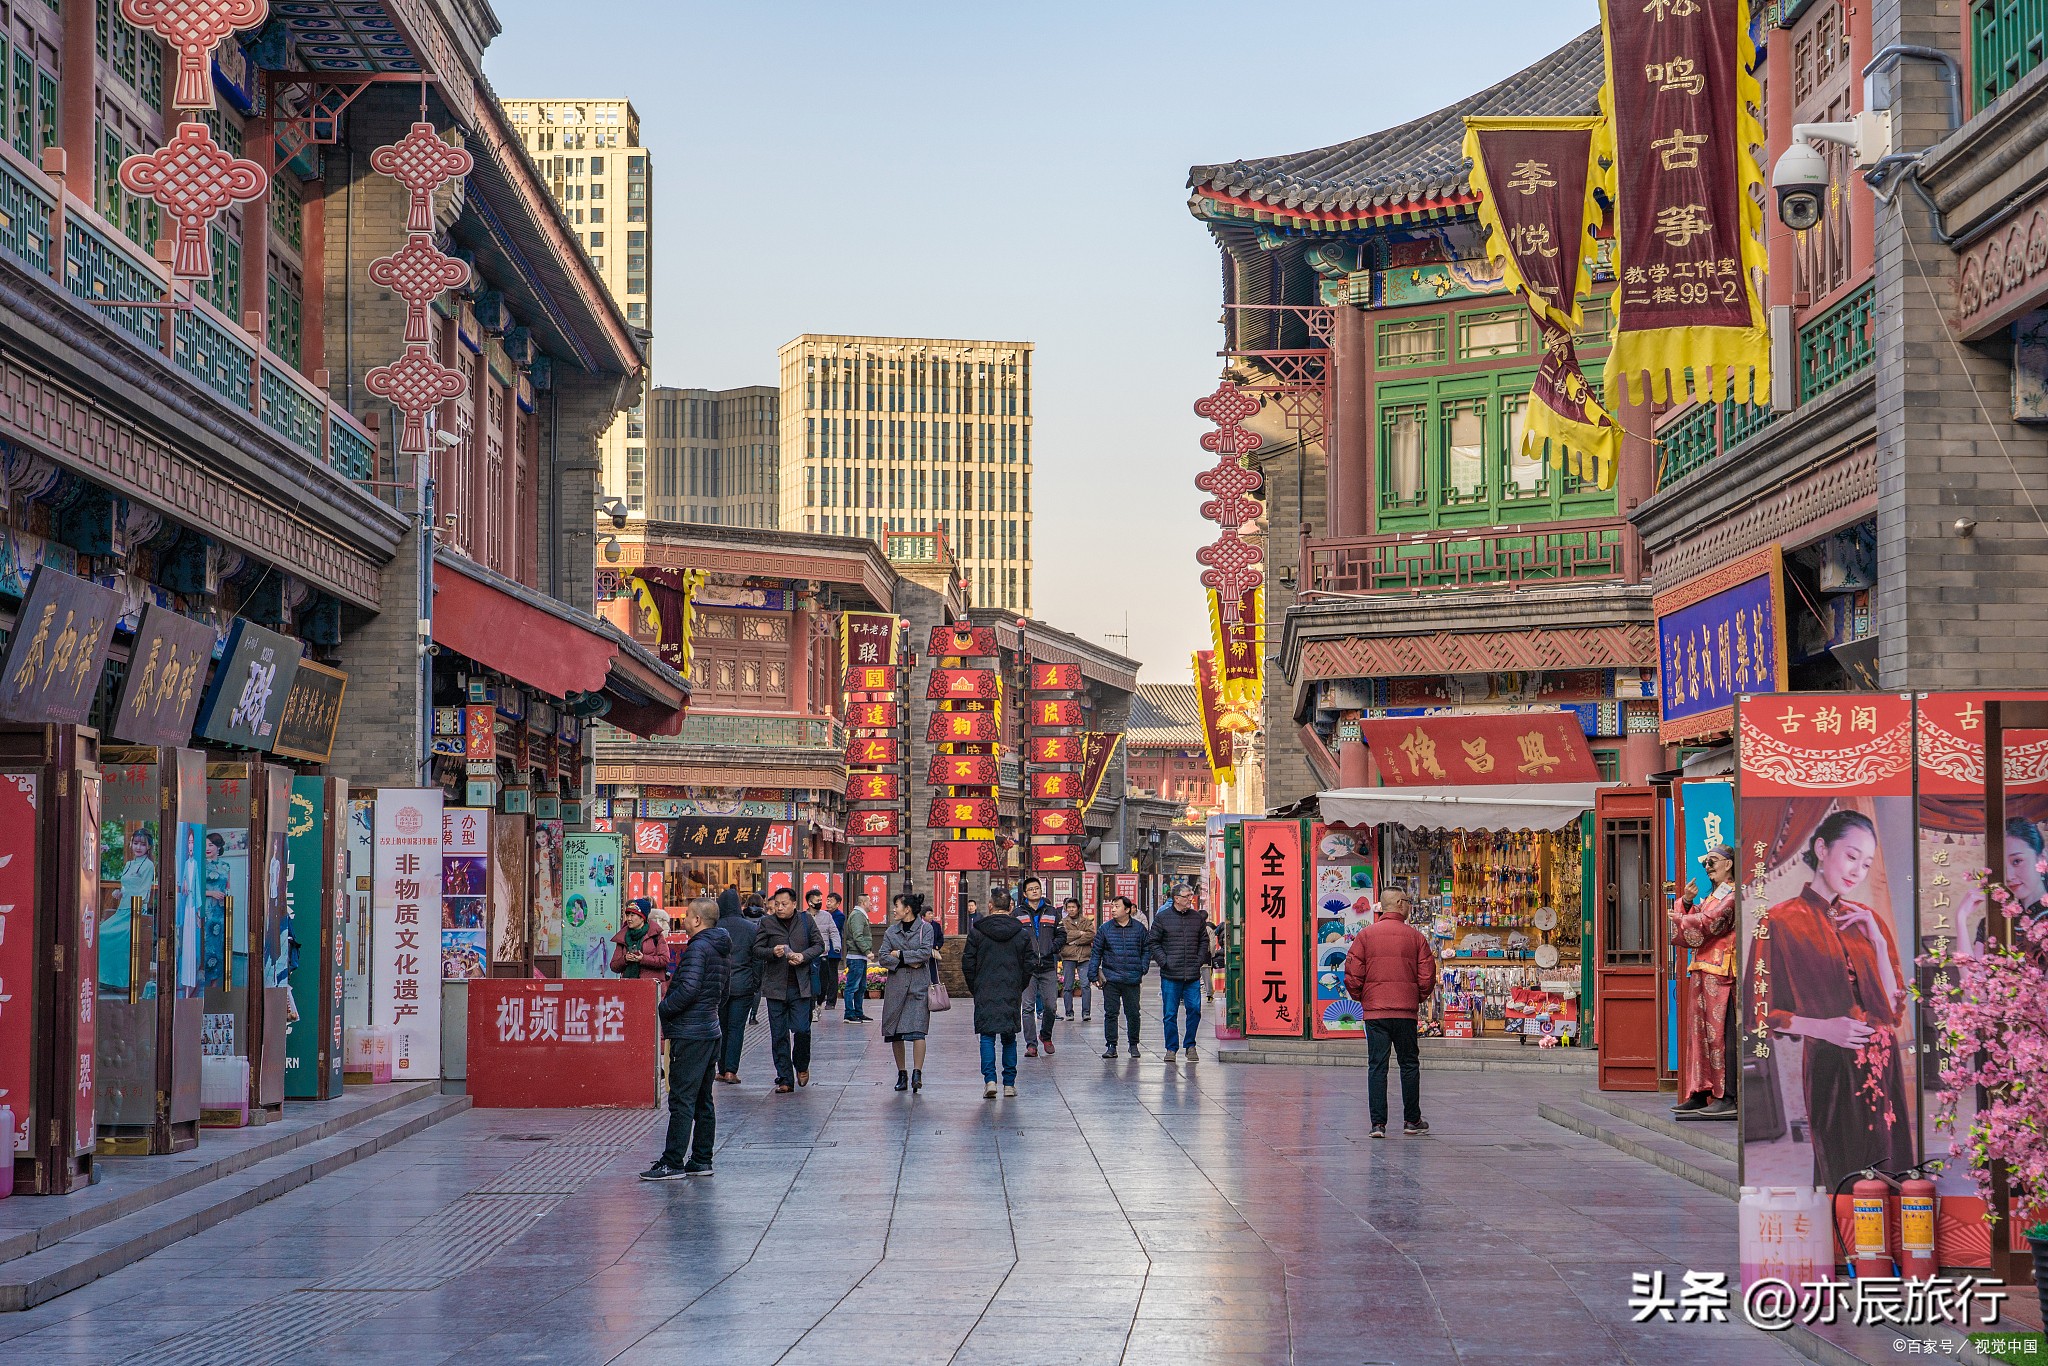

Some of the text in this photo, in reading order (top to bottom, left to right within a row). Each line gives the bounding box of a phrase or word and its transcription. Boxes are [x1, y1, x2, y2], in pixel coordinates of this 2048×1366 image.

[1624, 258, 1737, 284] 教学工作室
[1624, 280, 1739, 304] 二楼99-2
[851, 623, 889, 636] 百年老店
[858, 642, 879, 663] 联
[1776, 706, 1877, 734] 古韵阁
[1954, 702, 1984, 730] 古
[639, 824, 664, 851] 绣
[763, 828, 788, 853] 刺
[393, 853, 420, 1026] 非物质文化遗产
[1751, 840, 1771, 1059] 穿最美旗袍 来津门古韵
[496, 996, 625, 1042] 视频监控
